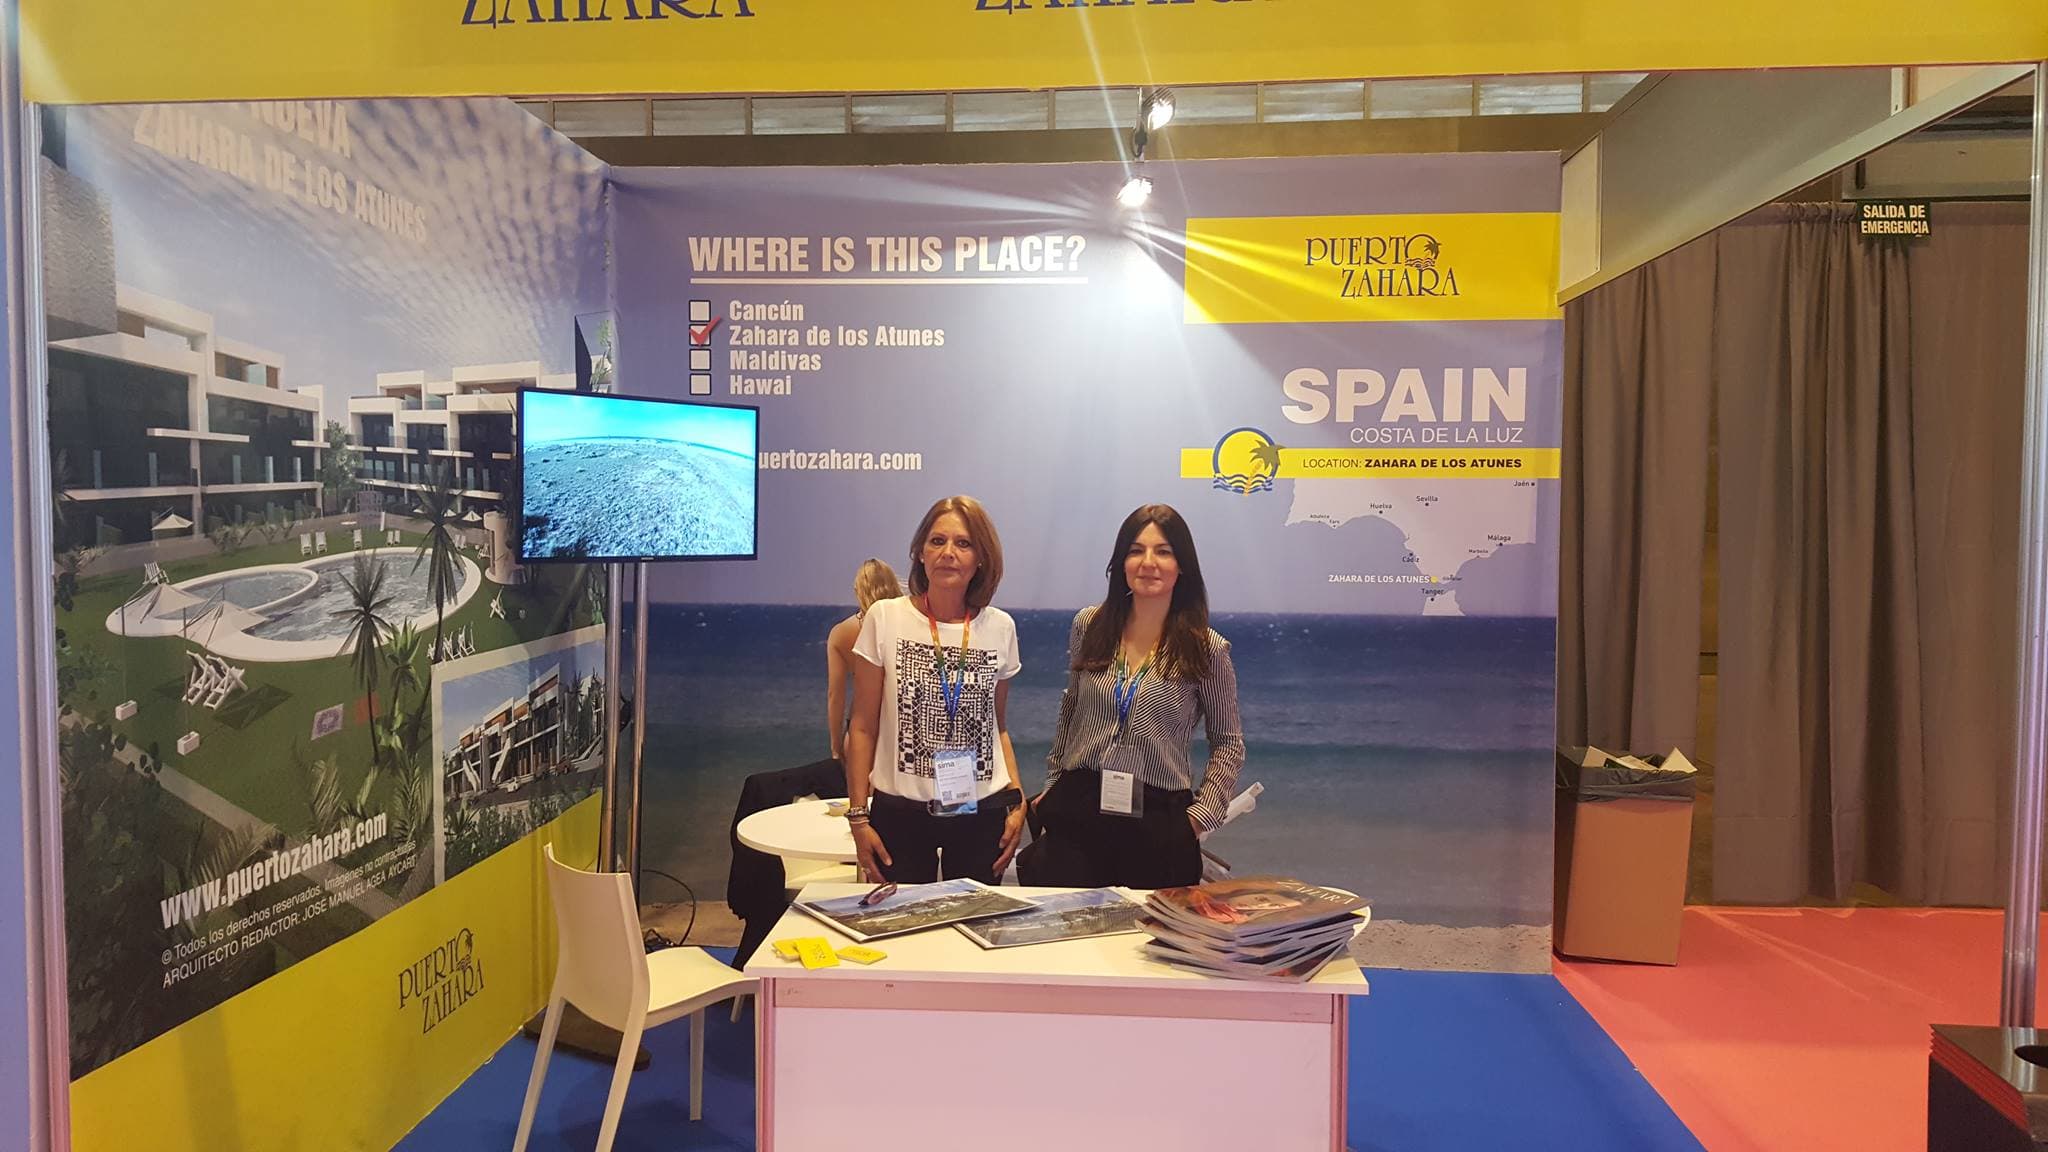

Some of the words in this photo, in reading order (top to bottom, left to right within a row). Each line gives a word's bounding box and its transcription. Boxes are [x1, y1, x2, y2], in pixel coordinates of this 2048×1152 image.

[134, 101, 257, 184] ZAHARA
[264, 144, 298, 198] DE
[304, 160, 348, 215] LOS
[354, 180, 427, 243] ATUNES
[1863, 204, 1906, 218] SALIDA
[1909, 205, 1926, 218] DE
[1861, 220, 1930, 234] EMERGENCIA
[687, 236, 809, 272] WHERE
[821, 236, 855, 273] IS
[866, 236, 943, 272] THIS
[954, 235, 1088, 272] PLACE?
[1304, 233, 1443, 268] PUERTO
[1340, 268, 1460, 299] ZAHARA
[729, 299, 804, 321] Cancún
[729, 325, 800, 346] Zahara
[806, 325, 831, 346] de
[838, 325, 869, 346] los
[875, 325, 946, 347] Atunes
[729, 350, 822, 371] Maldivas
[729, 375, 792, 396] Hawai
[1280, 366, 1528, 426] SPAIN
[1350, 427, 1415, 443] COSTA
[1421, 427, 1449, 443] DE
[1455, 427, 1479, 443] LA
[1485, 427, 1524, 443] LUZ
[1303, 458, 1363, 468] LOCATION:
[1364, 458, 1417, 468] ZAHARA
[1420, 458, 1438, 468] DE
[1441, 458, 1467, 468] LOS
[1470, 458, 1523, 468] ATUNES
[1513, 479, 1530, 487] Jaén
[1487, 534, 1512, 542] Málaga
[1328, 574, 1363, 583] ZAHARA
[1364, 575, 1375, 583] DE
[1377, 575, 1394, 583] LOS
[1395, 575, 1430, 584] ATUNES
[160, 811, 387, 930] www.puertozahara.com
[174, 937, 207, 959] Todos
[208, 928, 224, 945] los
[226, 907, 270, 936] derechos
[364, 861, 374, 873] no
[163, 940, 239, 988] ARQUITECTO
[241, 912, 301, 950] REDACTOR:
[328, 881, 365, 909] MANUEL
[398, 928, 474, 1010] PUERTO
[422, 958, 484, 1034] ZAHARA
